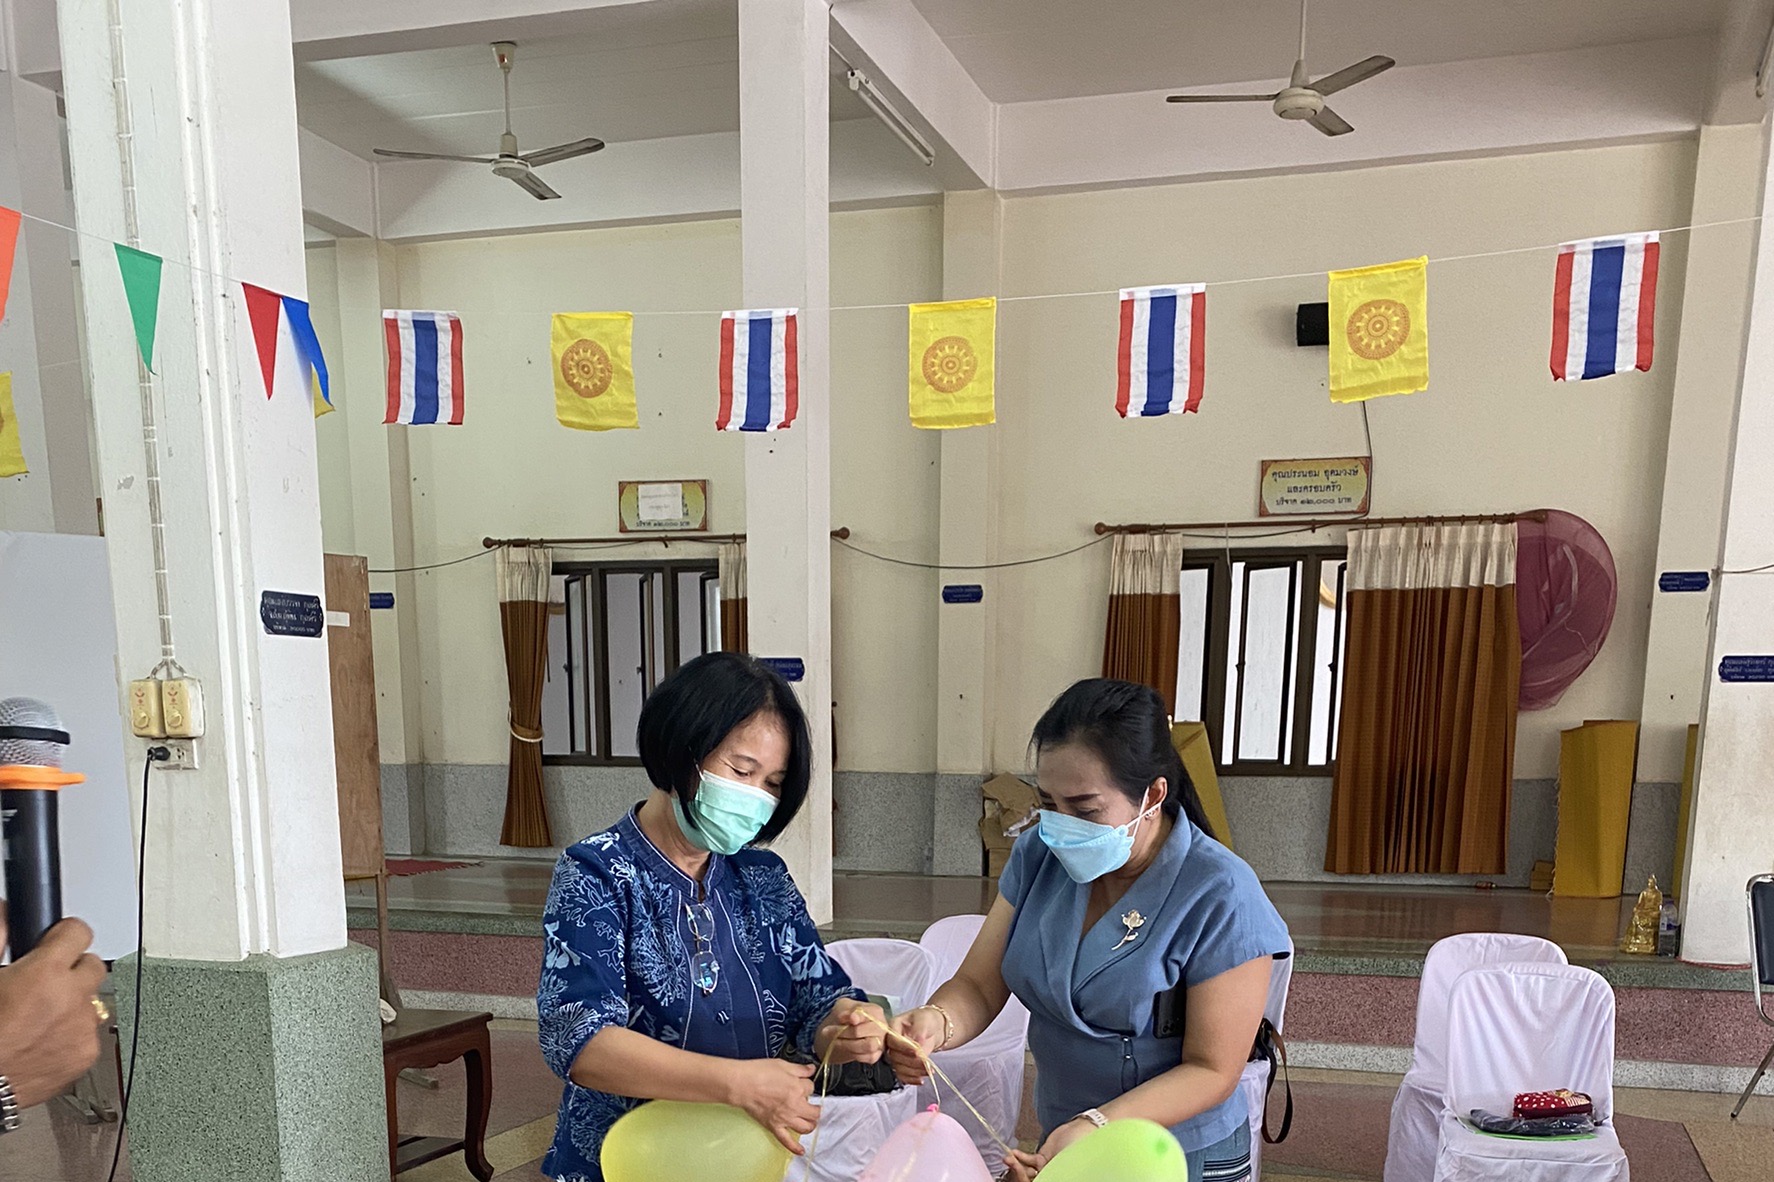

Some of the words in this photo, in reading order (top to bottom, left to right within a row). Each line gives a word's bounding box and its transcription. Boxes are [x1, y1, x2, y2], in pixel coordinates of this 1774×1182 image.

[1286, 480, 1342, 493] และครอบครัว
